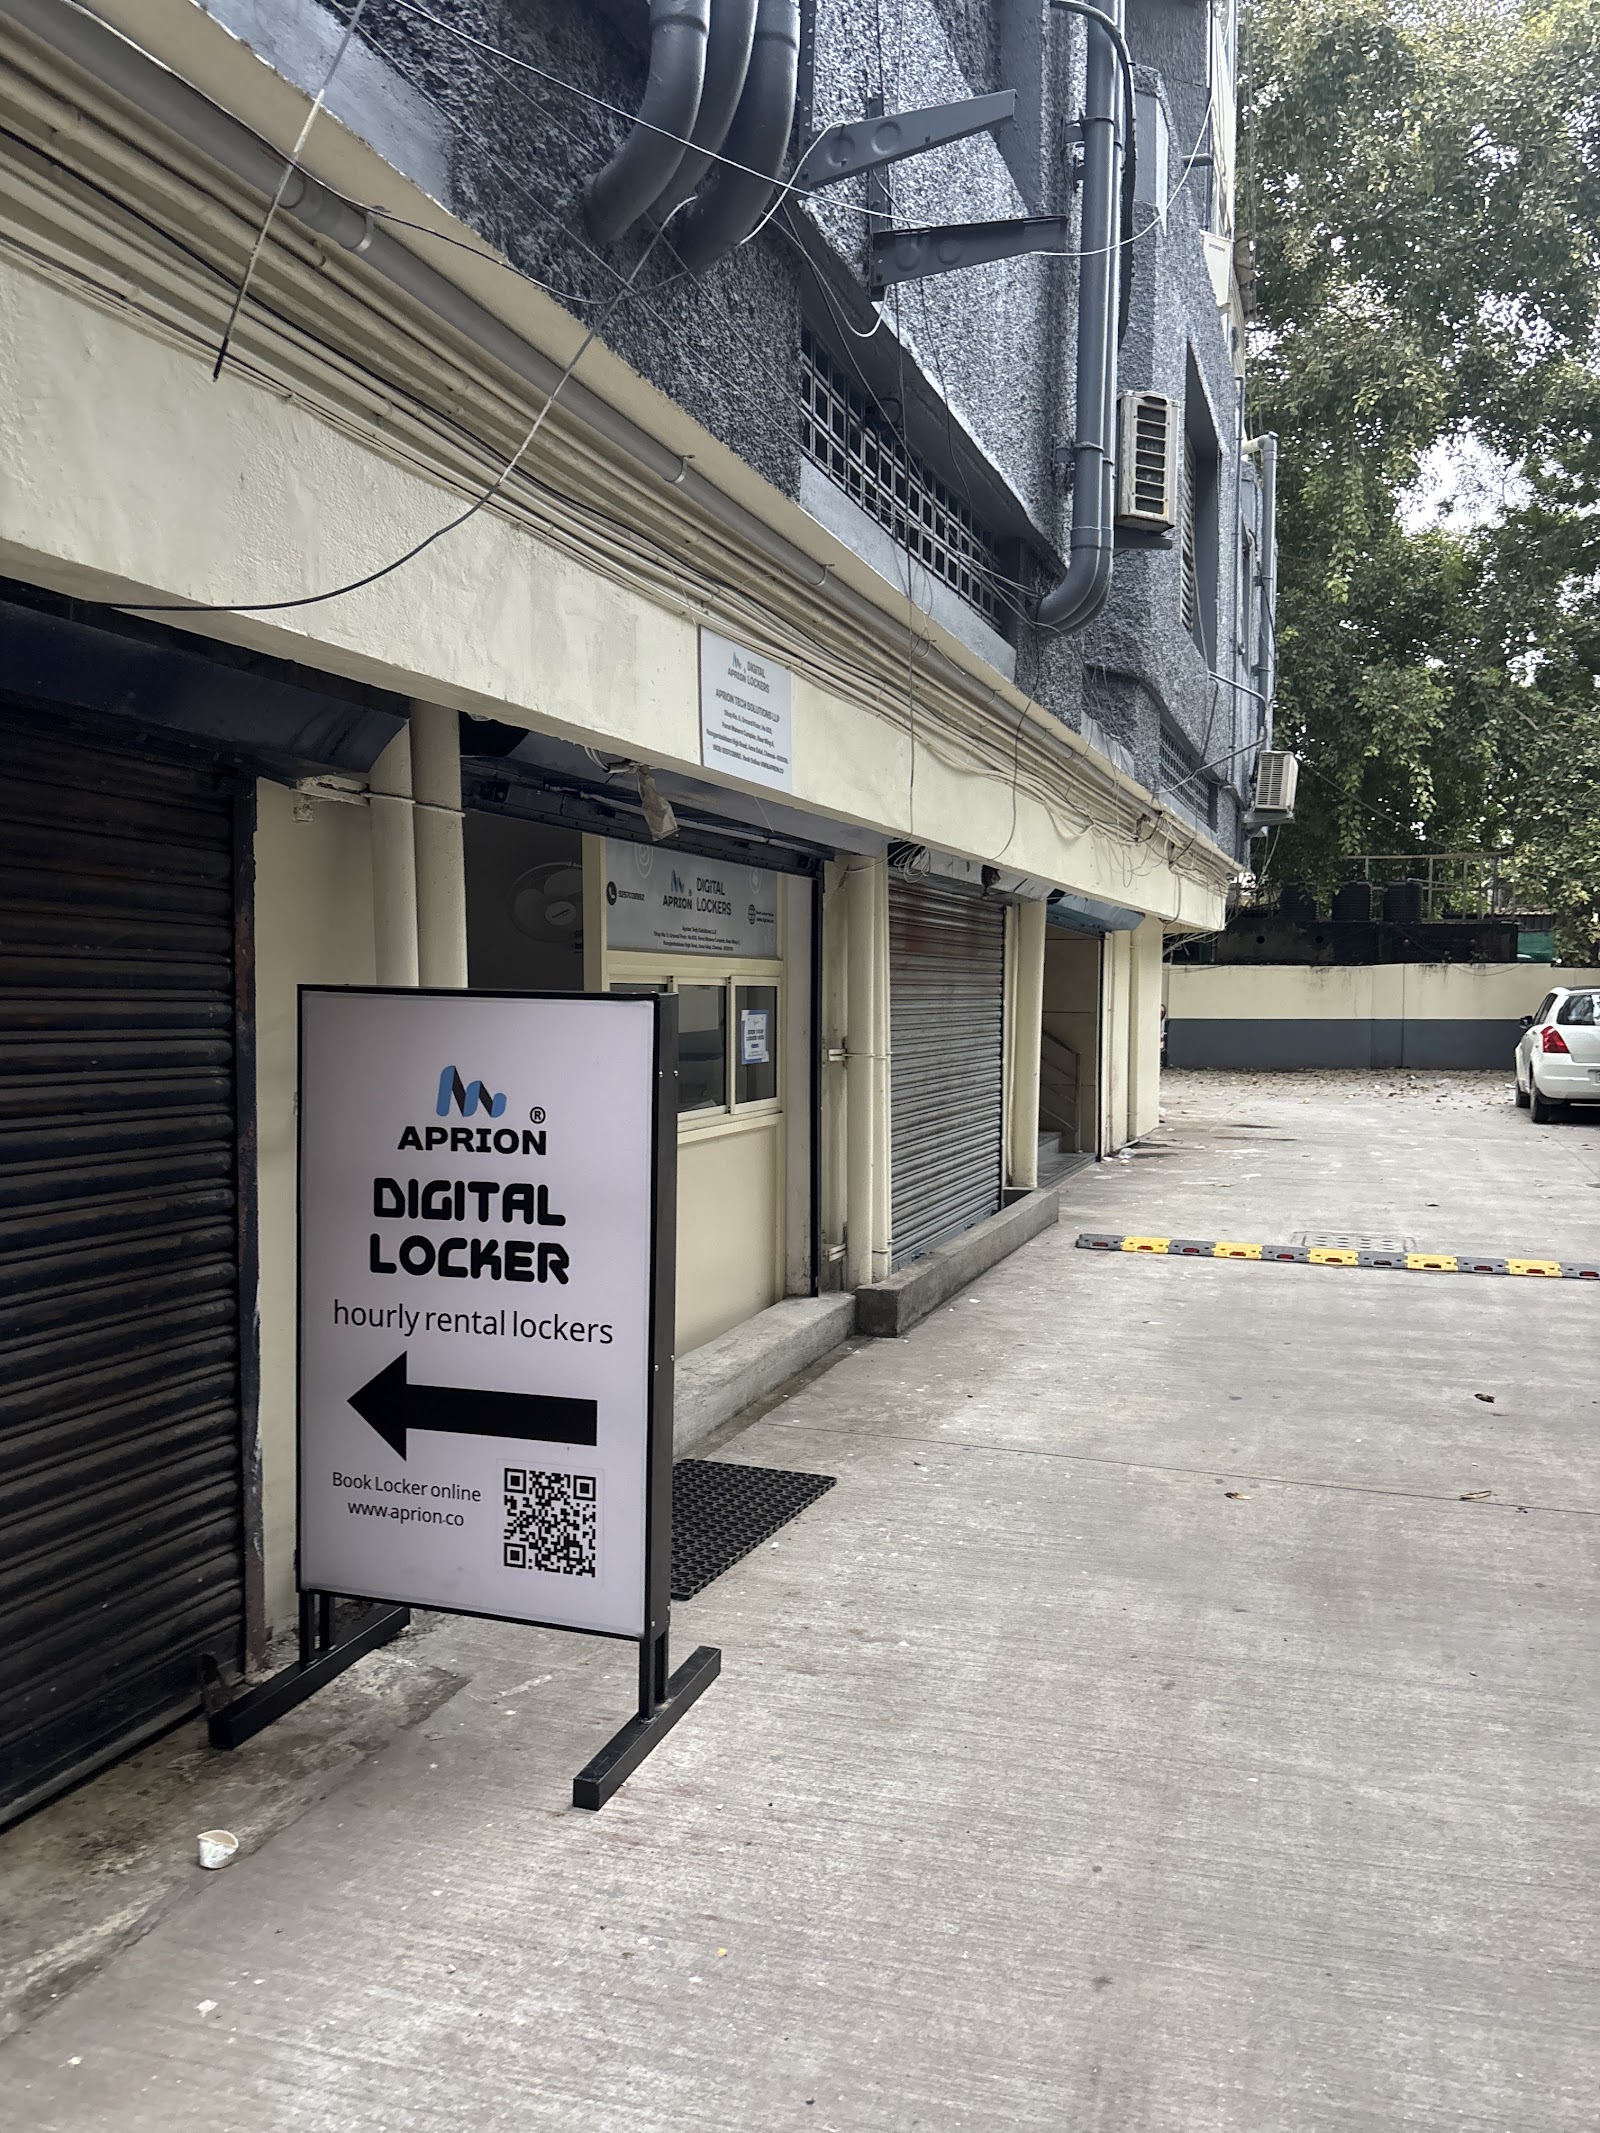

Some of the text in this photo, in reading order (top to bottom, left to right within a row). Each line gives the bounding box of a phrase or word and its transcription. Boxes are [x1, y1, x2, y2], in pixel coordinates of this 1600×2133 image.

[728, 668, 769, 693] APRION LOCKERS
[747, 661, 765, 678] DIGITAL
[716, 689, 734, 704] APRION
[735, 696, 746, 709] TECH
[747, 702, 771, 720] SOLUTIONS
[771, 713, 779, 722] LLP
[697, 877, 725, 895] DIGITAL
[663, 895, 731, 915] APRION LOCKERS
[397, 1126, 547, 1155] APRION
[373, 1177, 566, 1226] DIGITAL
[370, 1233, 570, 1285] LOCKER
[333, 1299, 613, 1344] hourly rental lockers
[332, 1472, 482, 1502] Book Locker online
[347, 1501, 464, 1526] www.aprion.co
